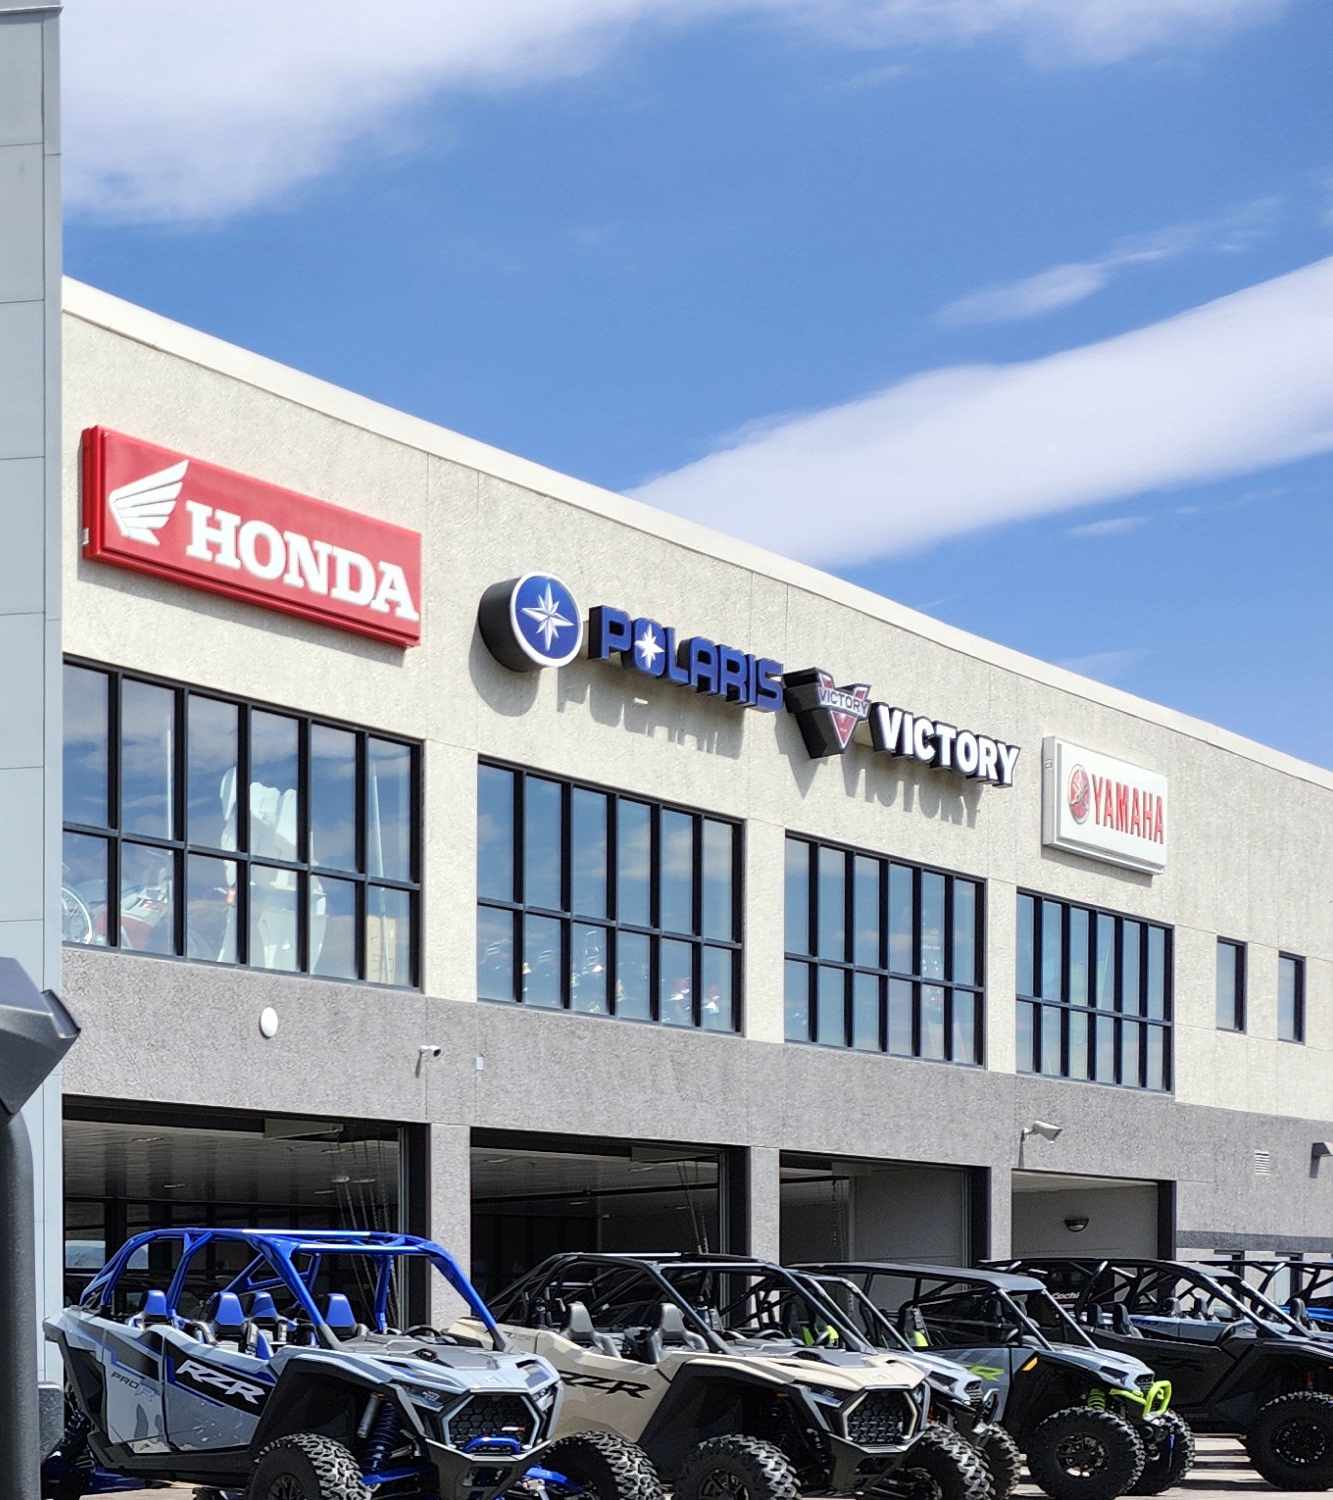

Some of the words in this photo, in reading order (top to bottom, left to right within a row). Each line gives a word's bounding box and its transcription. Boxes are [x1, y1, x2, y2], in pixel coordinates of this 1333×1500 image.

[185, 500, 419, 622] HONDA
[590, 604, 784, 712] POLARIS
[819, 688, 868, 714] VICTORY
[874, 702, 1021, 787] VICTORY
[1091, 773, 1164, 845] YAMAHA
[175, 1359, 266, 1405] RZR
